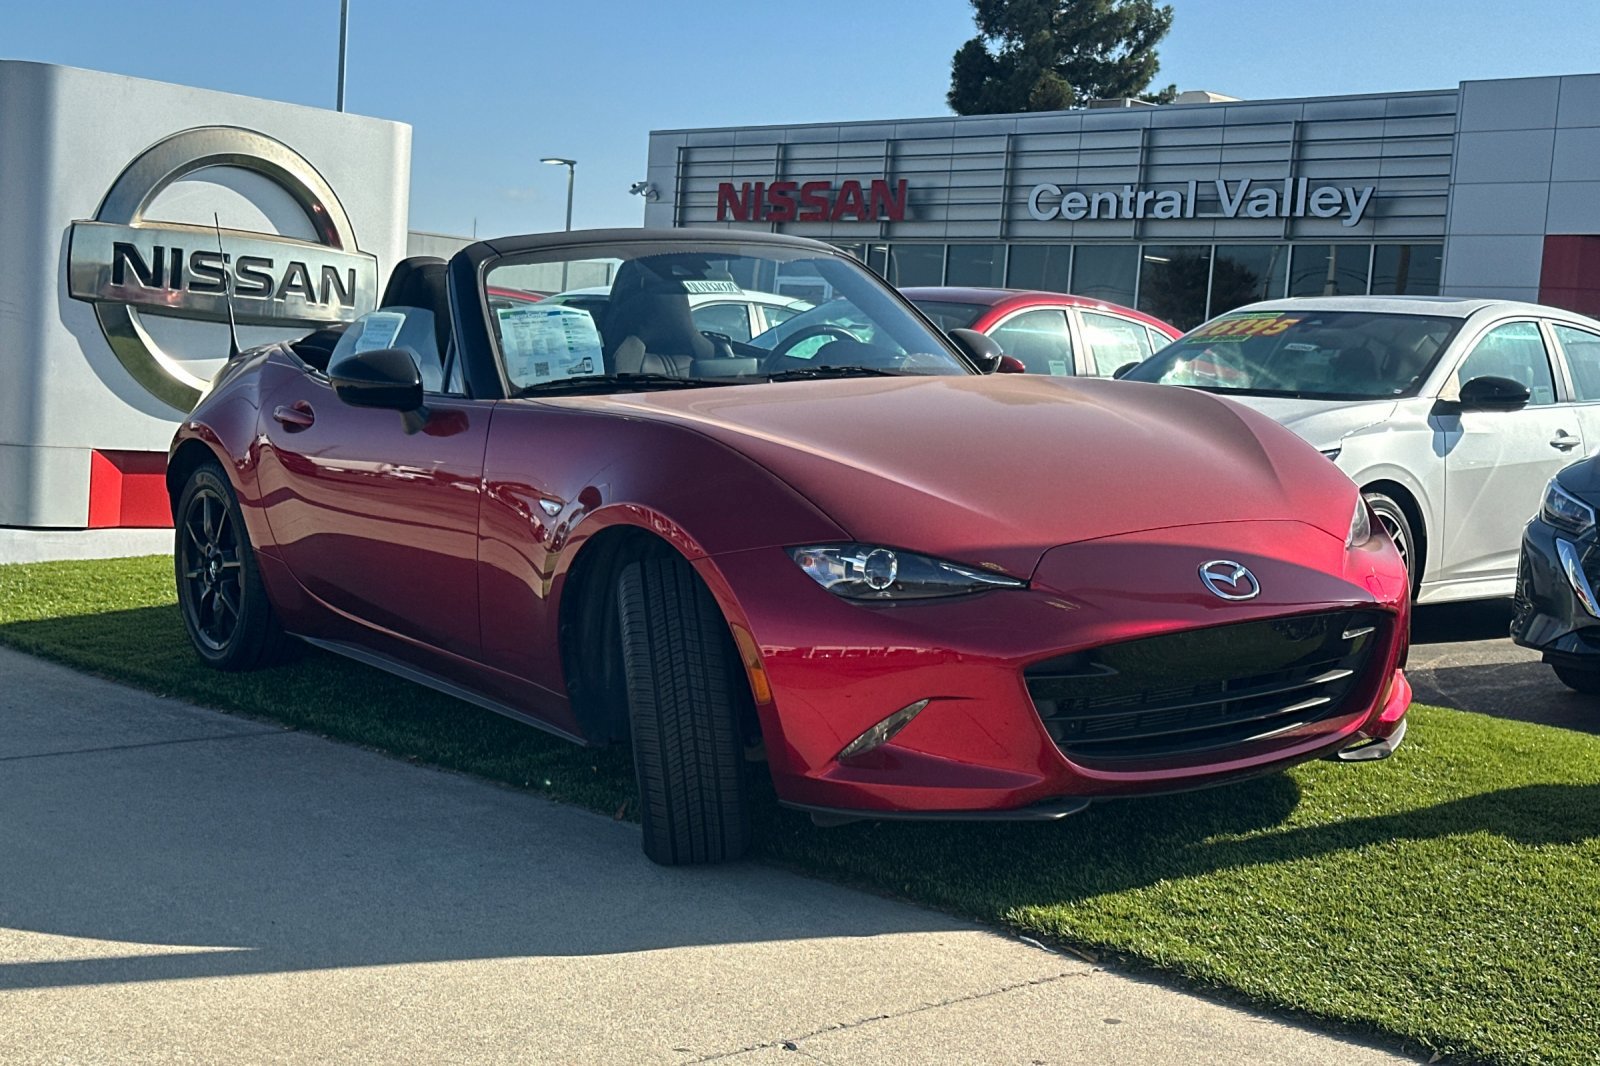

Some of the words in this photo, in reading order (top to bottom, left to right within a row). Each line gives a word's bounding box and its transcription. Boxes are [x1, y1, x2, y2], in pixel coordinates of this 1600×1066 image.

[716, 178, 909, 223] NISSAN
[1027, 179, 1198, 221] Central
[1214, 176, 1375, 227] Valley
[110, 241, 357, 309] NISSAN
